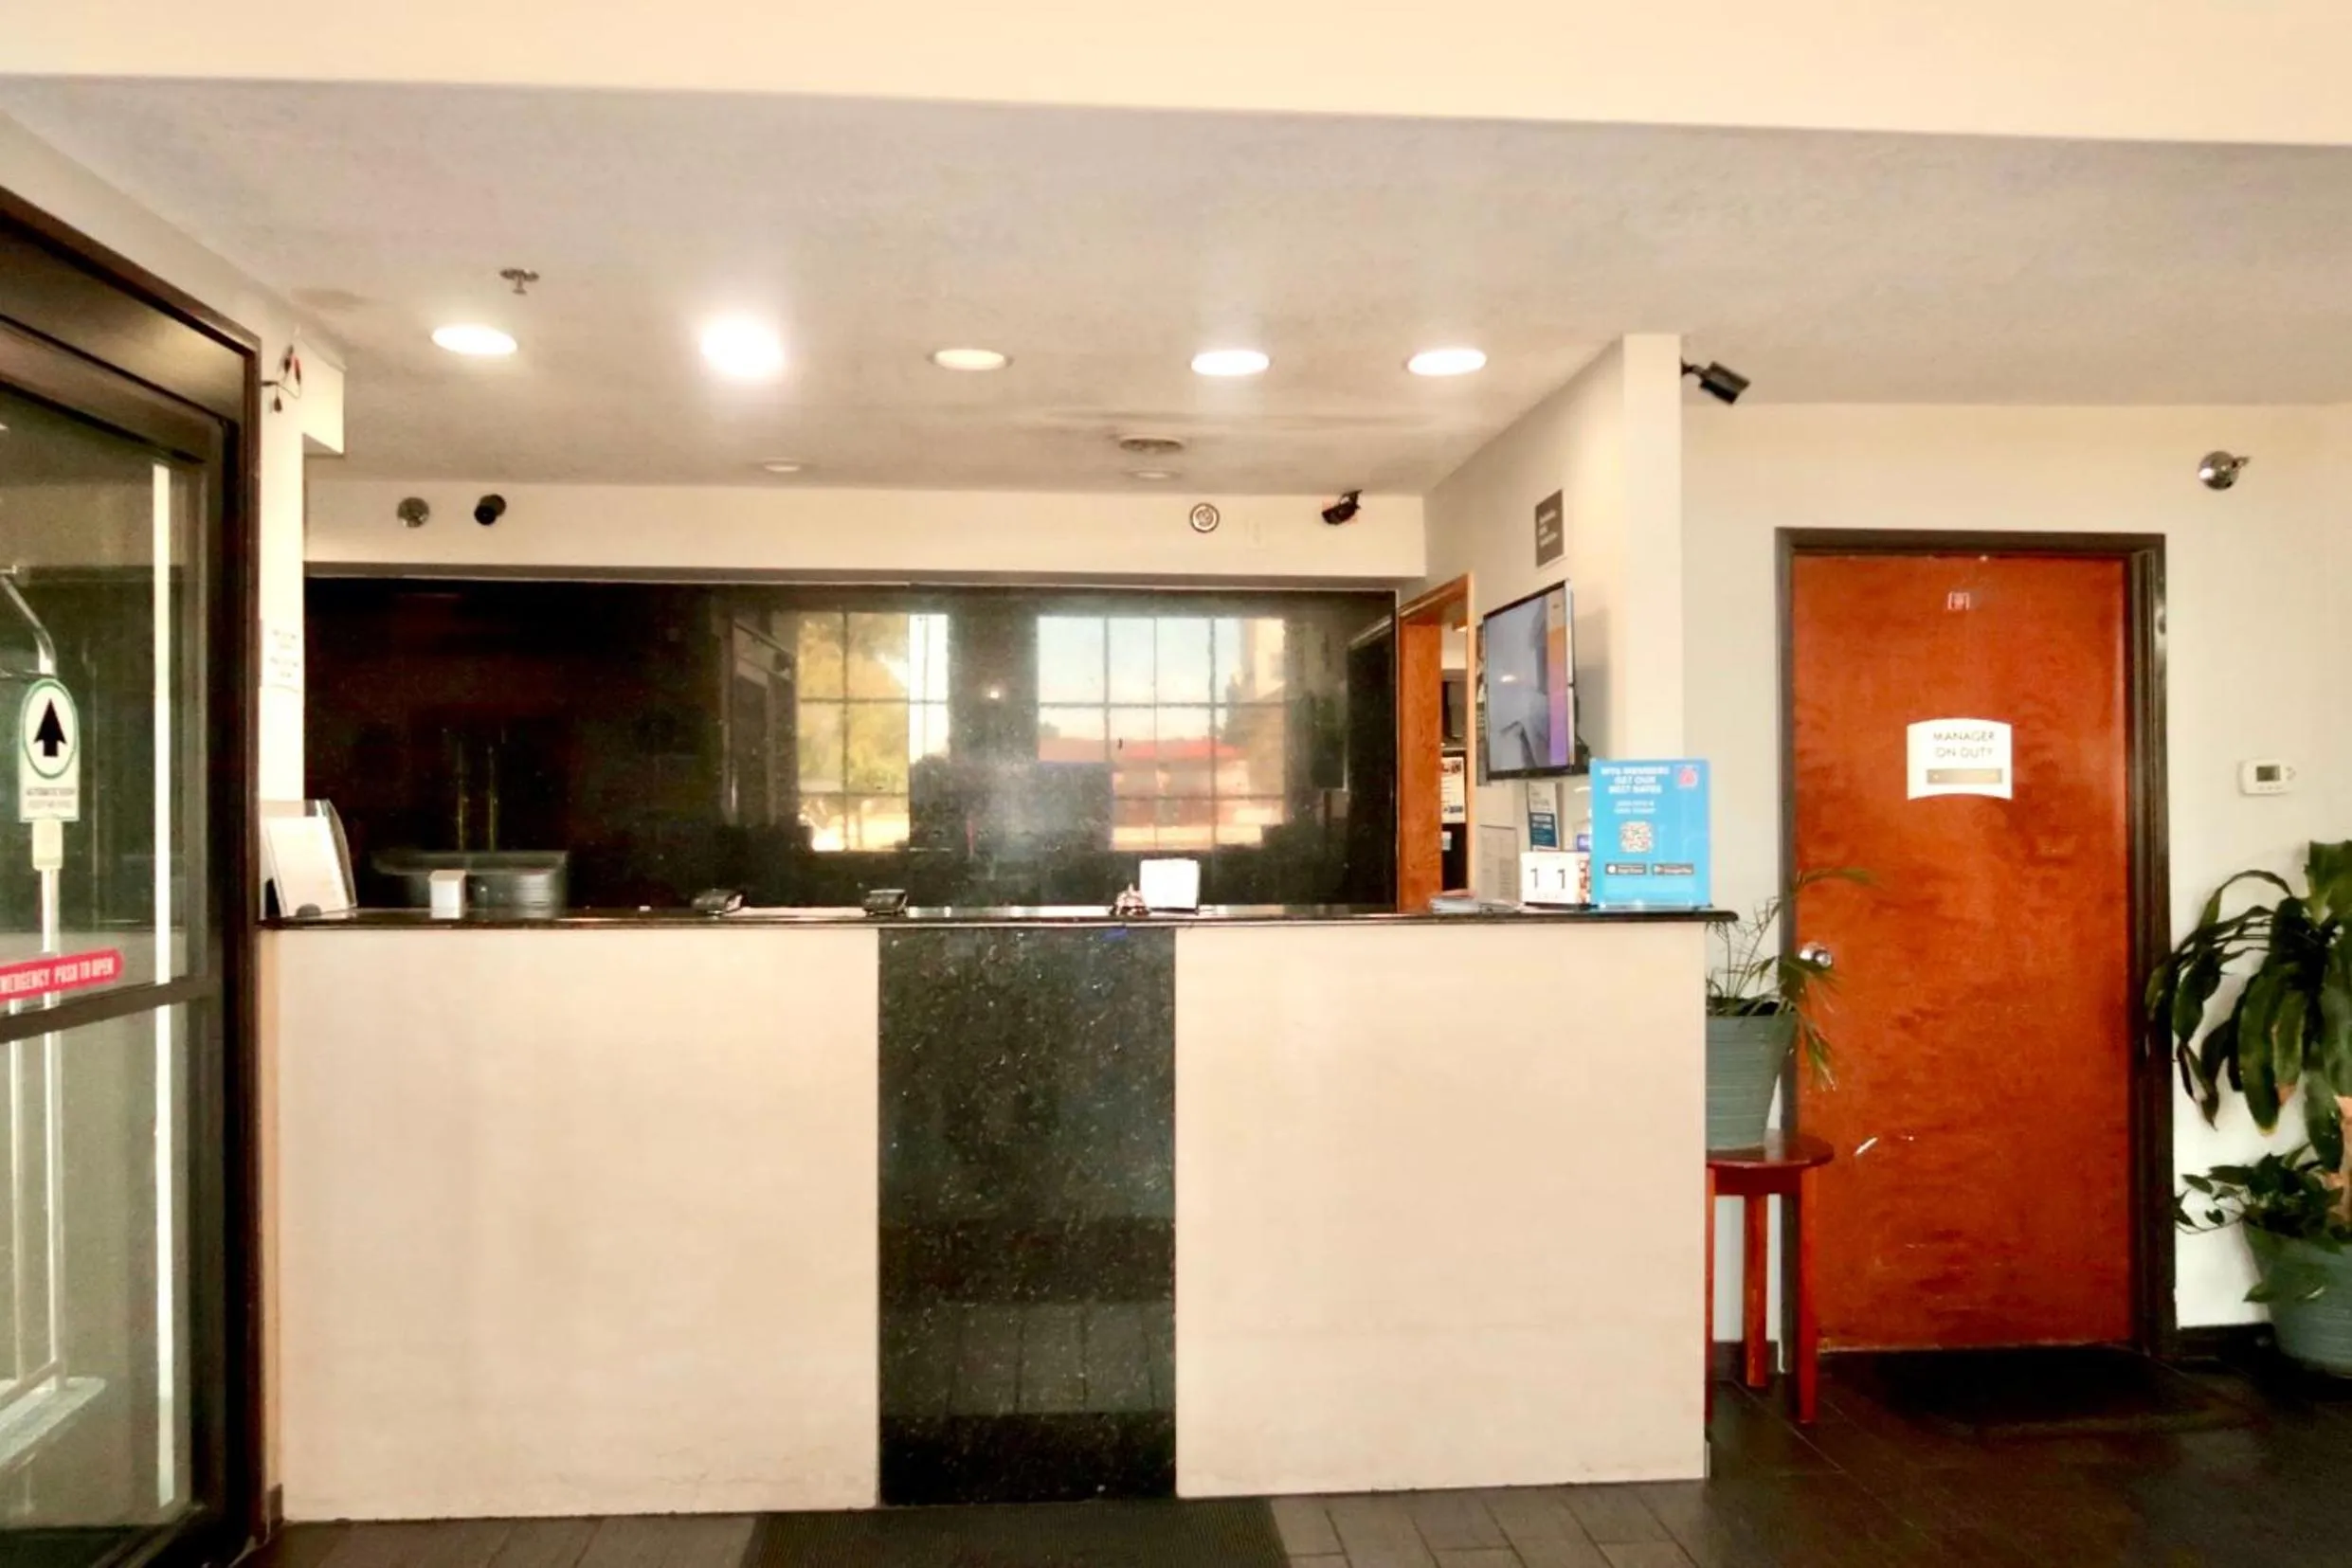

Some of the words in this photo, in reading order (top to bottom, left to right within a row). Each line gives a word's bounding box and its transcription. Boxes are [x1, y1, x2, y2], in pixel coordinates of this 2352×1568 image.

[1932, 730, 1995, 742] MANAGER
[1935, 747, 1957, 758] ON
[1960, 747, 1994, 758] DUTY
[0, 968, 51, 994] MERGENCY
[54, 963, 78, 984] PUSH
[79, 961, 91, 980] TO
[92, 957, 114, 977] OPEN
